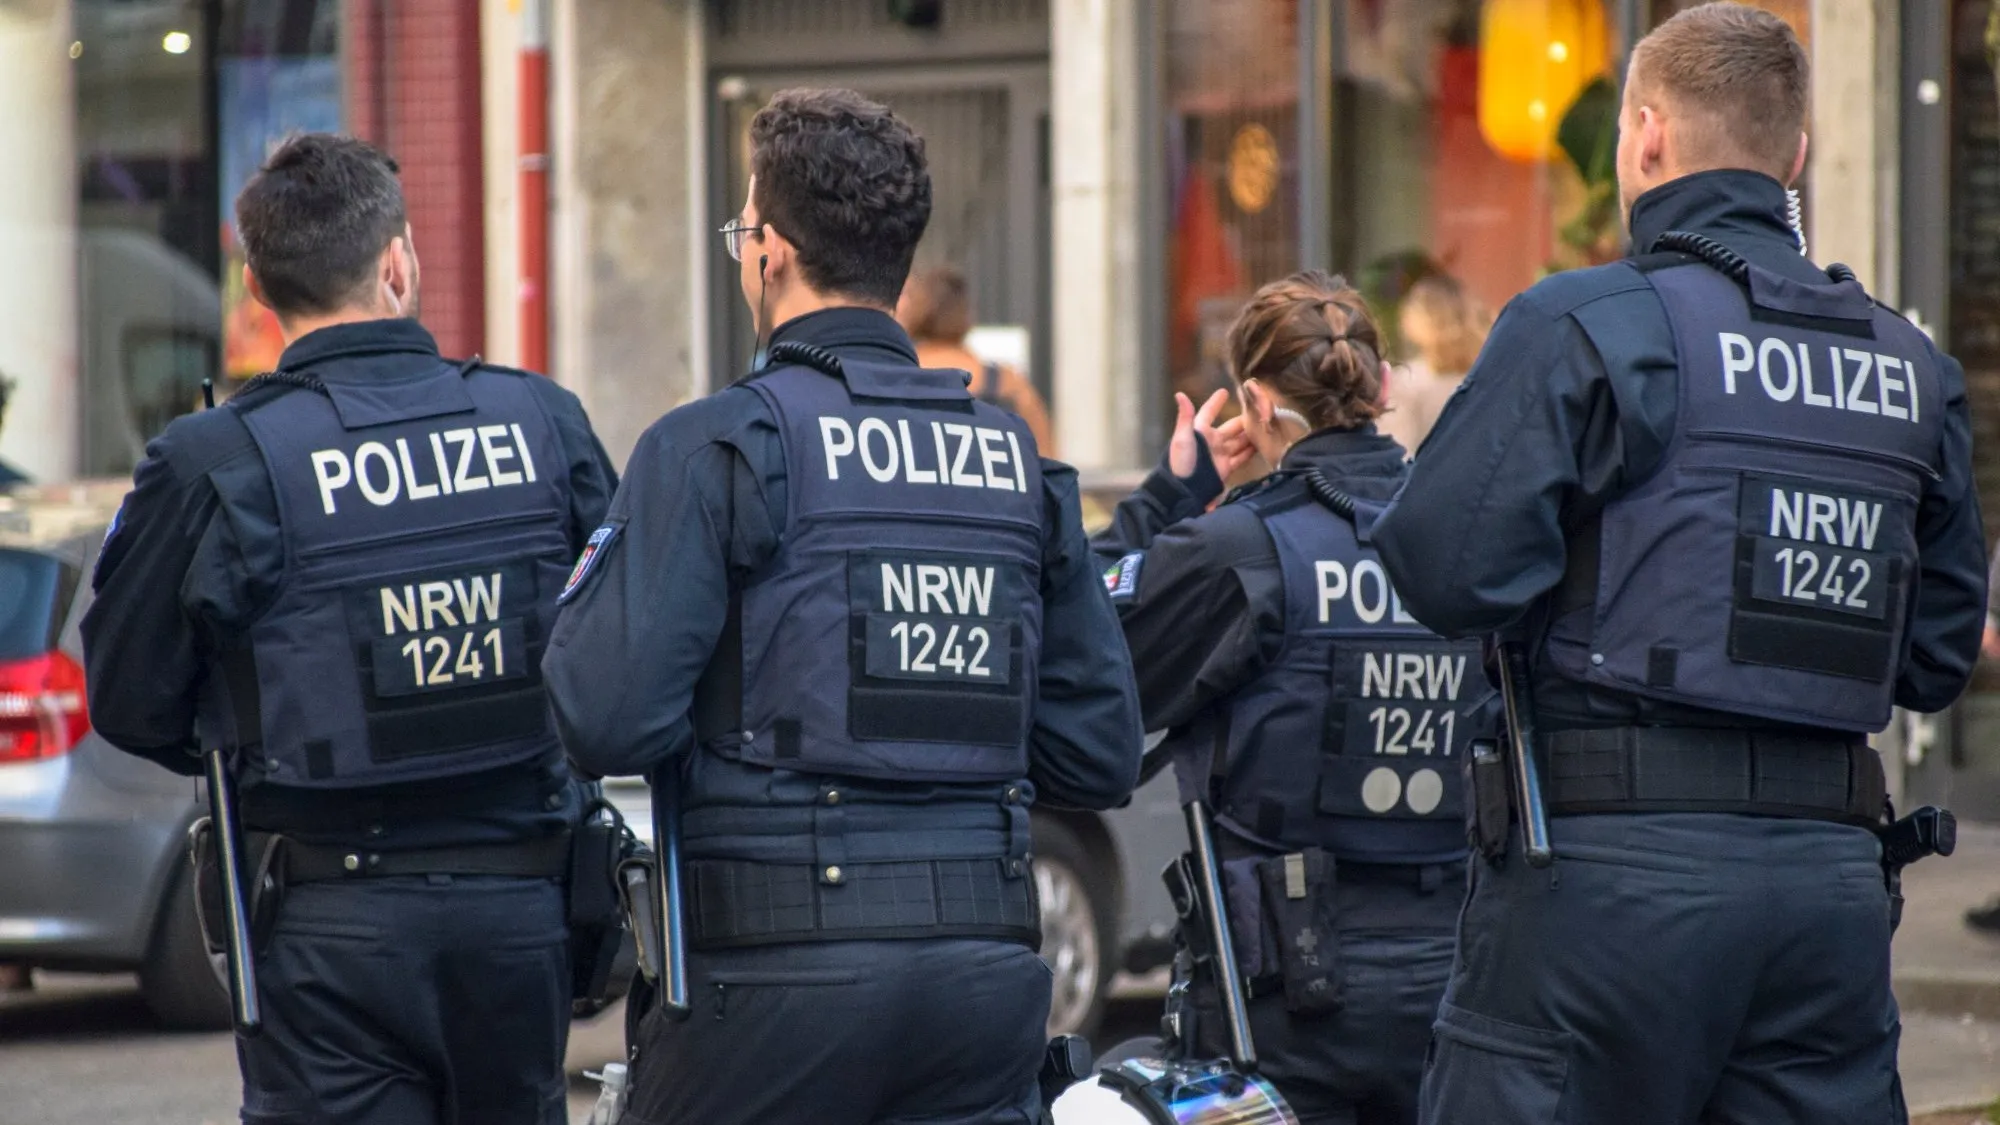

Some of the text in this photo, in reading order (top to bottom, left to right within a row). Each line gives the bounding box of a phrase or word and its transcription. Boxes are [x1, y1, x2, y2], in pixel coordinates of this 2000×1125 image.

[1719, 333, 1918, 422] POLIZEI
[311, 424, 536, 514] POLIZEI
[819, 417, 1027, 492] POLIZEI
[1770, 489, 1881, 549] NRW
[381, 573, 501, 634] NRW
[882, 564, 994, 615] NRW
[1774, 548, 1872, 608] 1242
[403, 633, 506, 685] 1241
[891, 622, 989, 676] 1242
[1363, 653, 1465, 700] NRW
[1369, 707, 1455, 755] 1241
